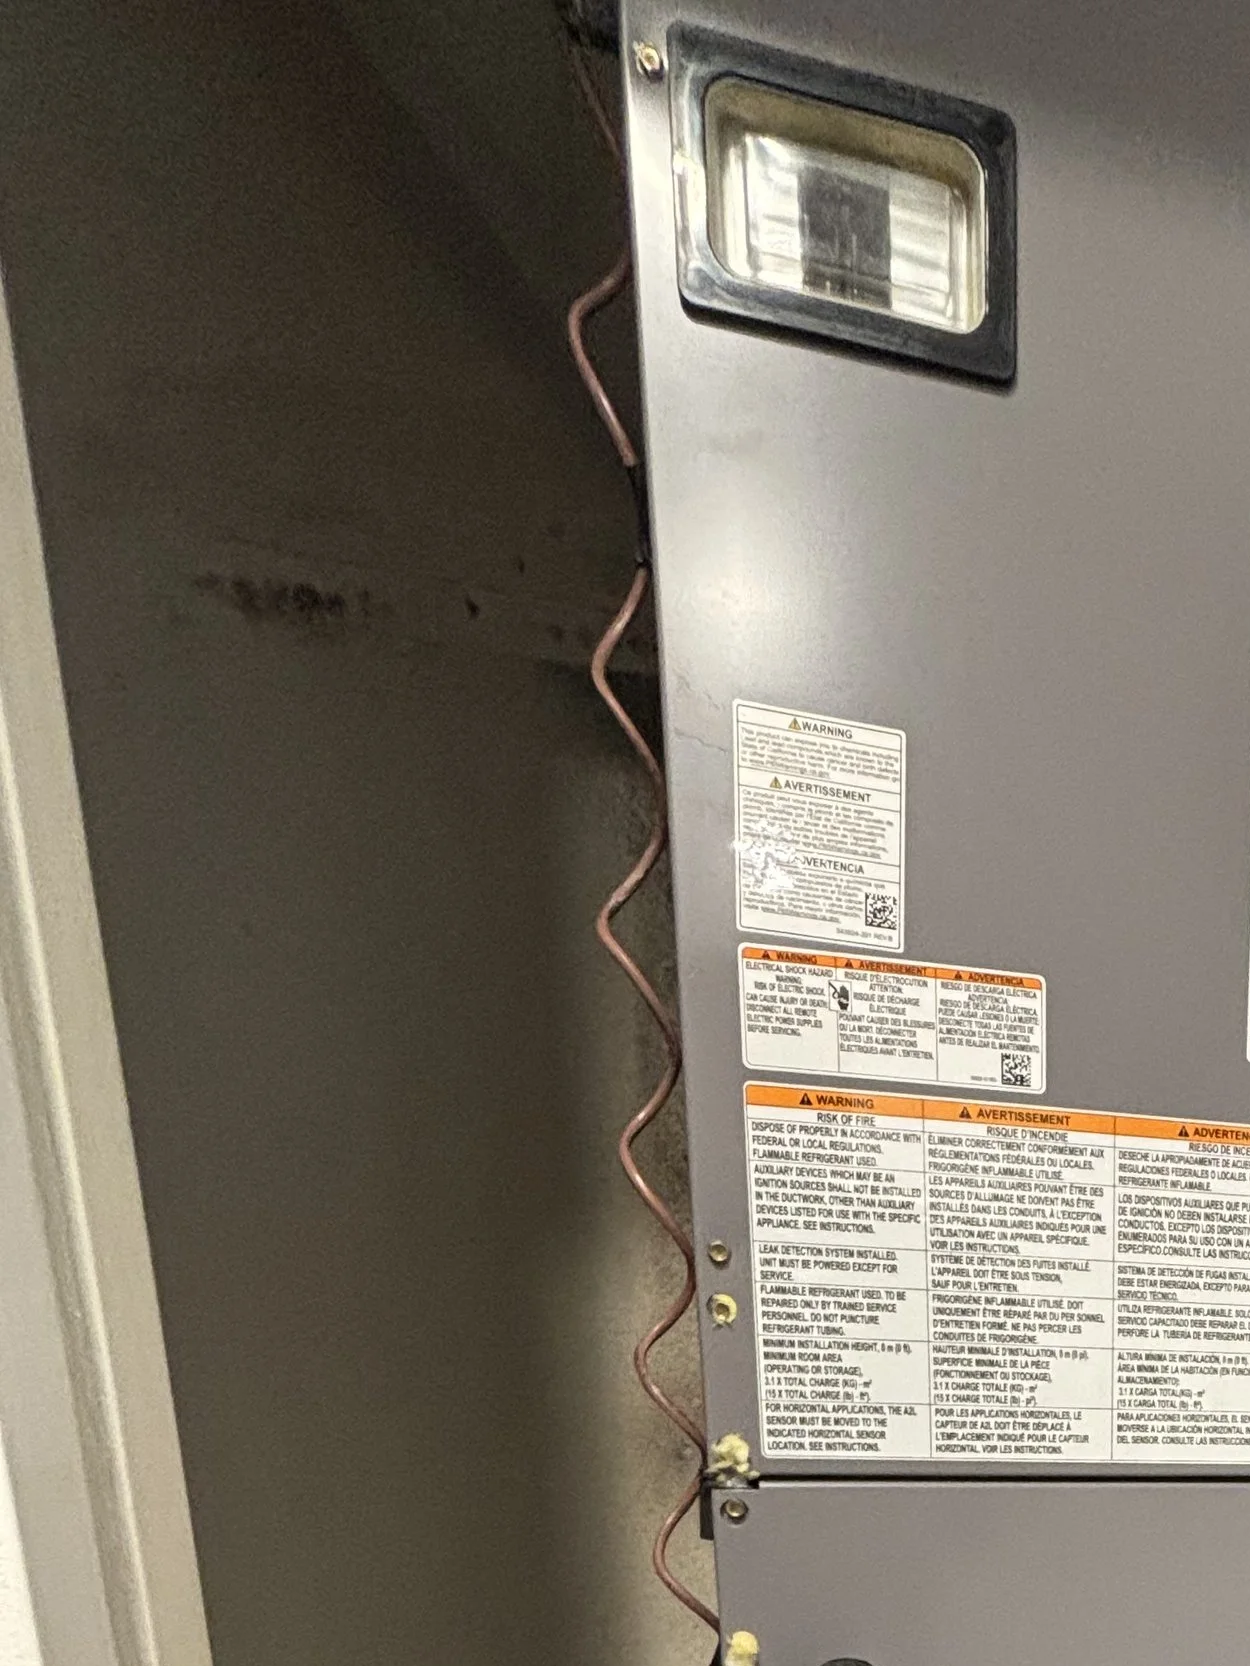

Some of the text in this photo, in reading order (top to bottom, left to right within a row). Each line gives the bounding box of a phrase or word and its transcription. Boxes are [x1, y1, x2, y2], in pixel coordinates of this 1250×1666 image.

[802, 721, 852, 739] WARNING
[784, 779, 871, 803] AVERTISSEMENT
[794, 854, 865, 875] VERTENCIA
[776, 951, 817, 964] WARNING
[746, 961, 832, 976] ELECTRICAL SHOCK HAZARD
[858, 960, 927, 977] AVERTISSEMENT
[967, 972, 1024, 986] ADVERTENCIA
[816, 1094, 873, 1109] WARNING
[817, 1112, 875, 1126] RISK OF FIRE
[977, 1108, 1070, 1125] AVERTISSEMENT
[751, 1120, 921, 1143] DISPOSE OF PROPERLY IN ACCORDANCE WITH
[987, 1126, 1067, 1142] RISQUE D'INCENDIE
[752, 1134, 785, 1146] FEDERAL
[788, 1137, 800, 1147] OR
[802, 1138, 825, 1149] LOCAL
[1188, 1143, 1218, 1153] RIESGO
[1220, 1145, 1230, 1154] DE
[752, 1148, 799, 1161] FLAMMABLE
[801, 1152, 853, 1164] REFRIGERANT
[753, 1163, 894, 1182] AUXILIARY DEVICES WHICH MAY BE AN
[1118, 1163, 1169, 1175] REGULACIONES
[1171, 1167, 1208, 1178] FEDERALES
[1210, 1170, 1215, 1179] O
[754, 1177, 921, 1197] IGNITION SOURCES SHALL NOT BE INSTALLED
[755, 1191, 763, 1201] IN
[765, 1191, 779, 1202] THE
[828, 1196, 854, 1207] OTHER
[856, 1197, 876, 1208] THAN
[877, 1199, 914, 1211] AUXILIARY
[755, 1204, 920, 1223] DEVICES LISTED FOR USE WITH THE SPECIFIC
[802, 1220, 817, 1230] SEE
[759, 1244, 778, 1254] LEAK
[781, 1245, 823, 1256] DETECTION
[825, 1247, 854, 1258] SYSTEM
[930, 1239, 948, 1250] VOIR
[949, 1240, 963, 1250] LES
[759, 1257, 897, 1273] UNIT MUST BE POWERED EXCEPT FOR
[760, 1285, 806, 1296] FLAMMABLE
[808, 1287, 859, 1298] REFRIGERANT
[885, 1291, 894, 1300] TO
[896, 1291, 905, 1300] BE
[761, 1297, 896, 1312] REPAIRED ONLY BY TRAINED SERVICE
[810, 1312, 821, 1322] DO
[823, 1313, 838, 1322] NOT
[840, 1314, 879, 1324] PUNCTURE
[762, 1323, 813, 1334] REFRIGERANT
